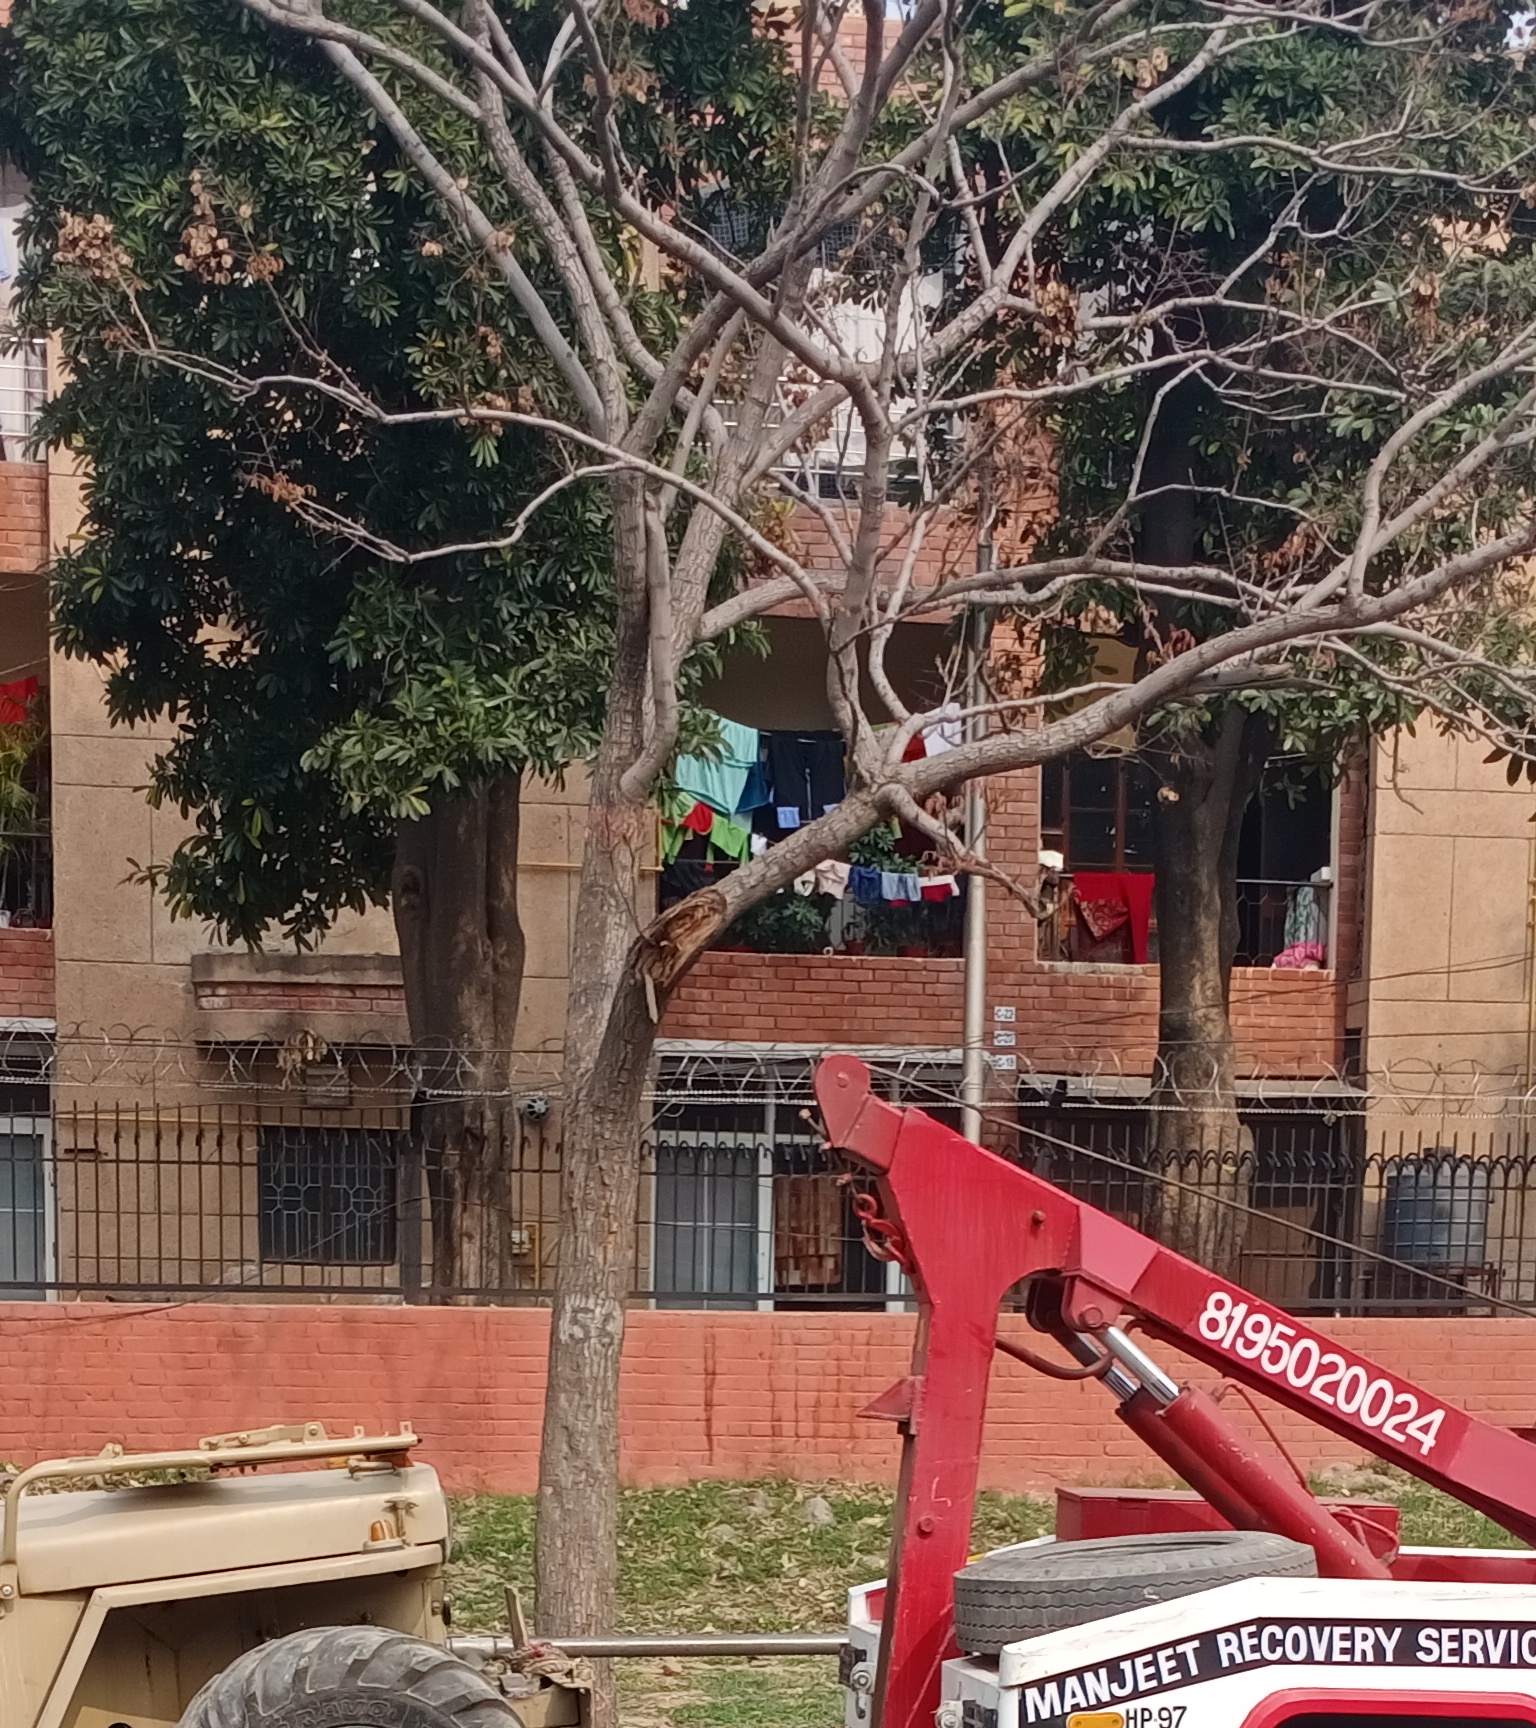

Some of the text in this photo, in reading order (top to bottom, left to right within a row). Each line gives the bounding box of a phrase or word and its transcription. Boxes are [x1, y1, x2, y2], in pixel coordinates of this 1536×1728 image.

[1199, 1291, 1446, 1456] 8195020024
[1024, 1639, 1201, 1724] MANJEET
[1216, 1624, 1403, 1668] RECOVERY
